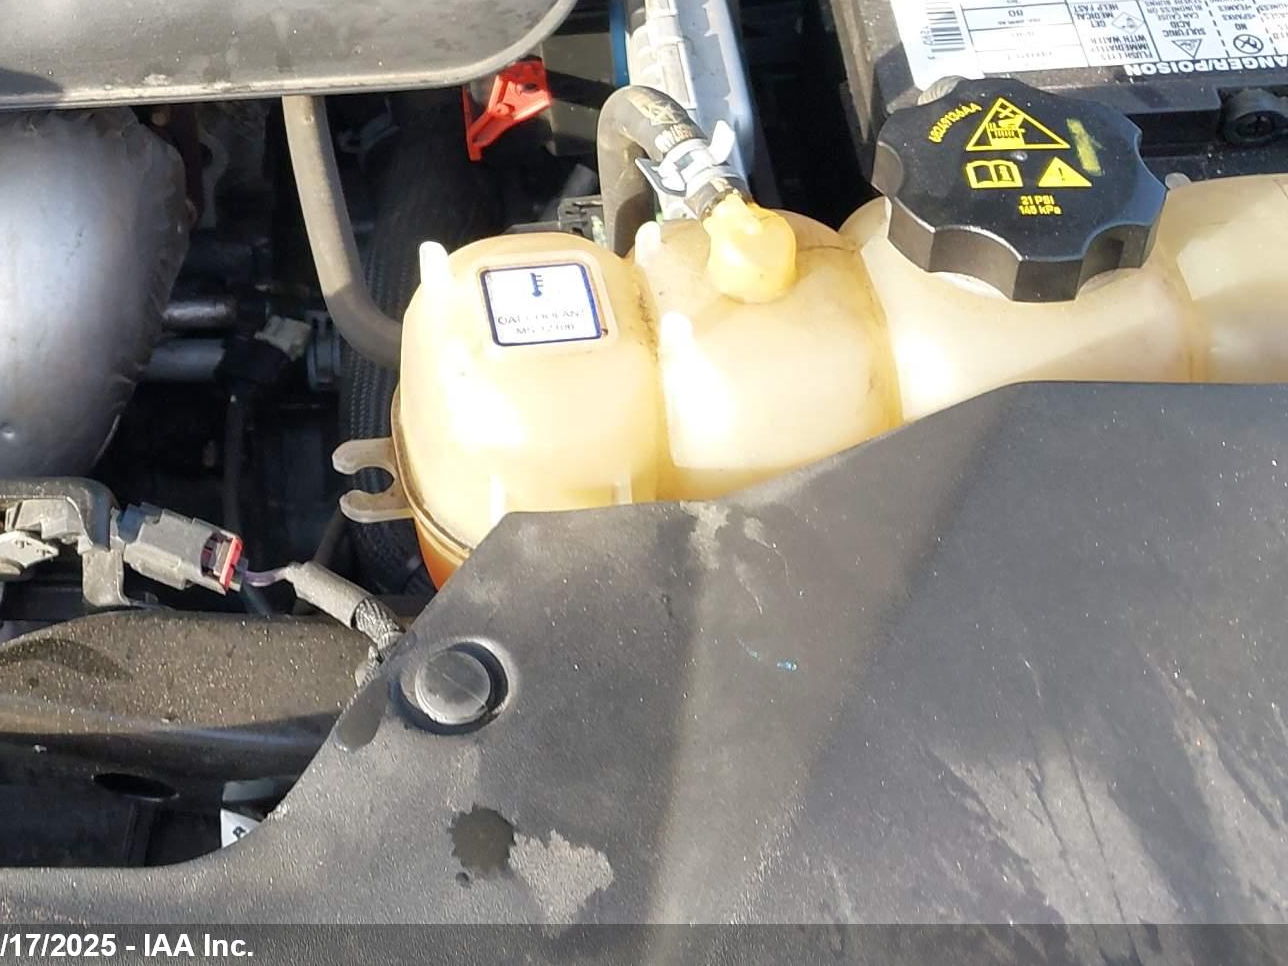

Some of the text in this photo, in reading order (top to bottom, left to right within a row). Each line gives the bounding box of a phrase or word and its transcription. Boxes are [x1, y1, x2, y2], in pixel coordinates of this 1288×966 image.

[1073, 12, 1114, 21] MEDICAL
[1090, 20, 1106, 28] GET
[1170, 20, 1192, 28] ACID
[1122, 34, 1147, 44] WITH
[1020, 194, 1055, 205] 21 PSI
[1038, 204, 1062, 215] kPa
